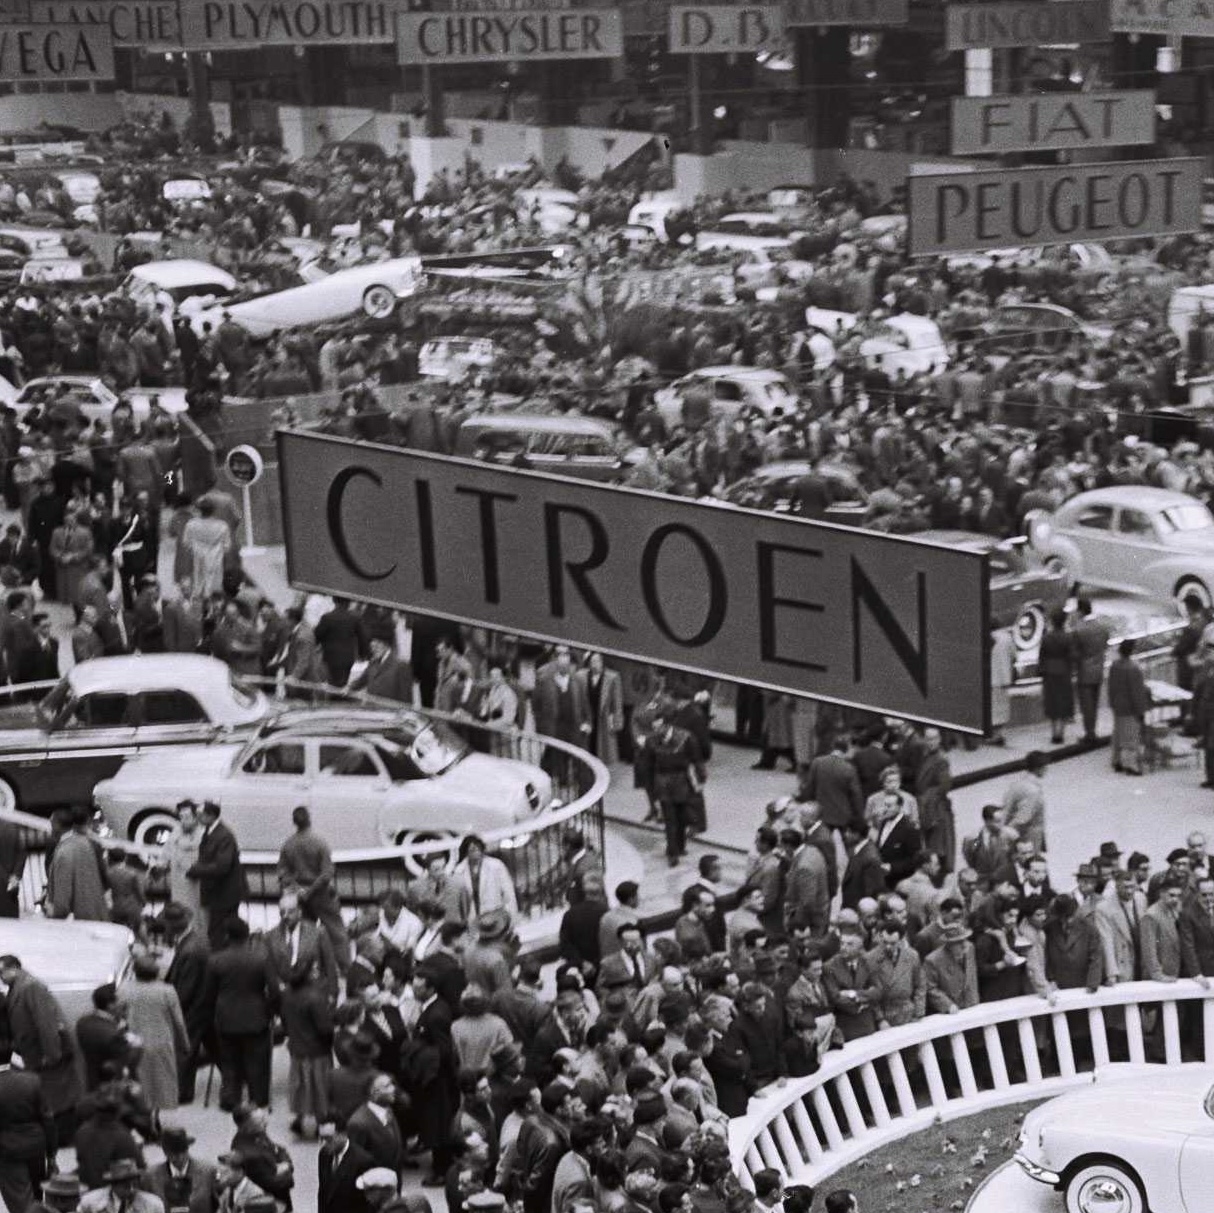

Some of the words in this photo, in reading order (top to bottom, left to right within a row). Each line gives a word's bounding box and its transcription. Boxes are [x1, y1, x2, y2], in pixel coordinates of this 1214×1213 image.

[204, 2, 387, 38] PLYMOUTH
[417, 14, 601, 57] CHRYSLER
[982, 99, 1127, 145] FIAT
[935, 170, 1182, 244] PEUGEOT
[325, 464, 930, 700] CITROEN
